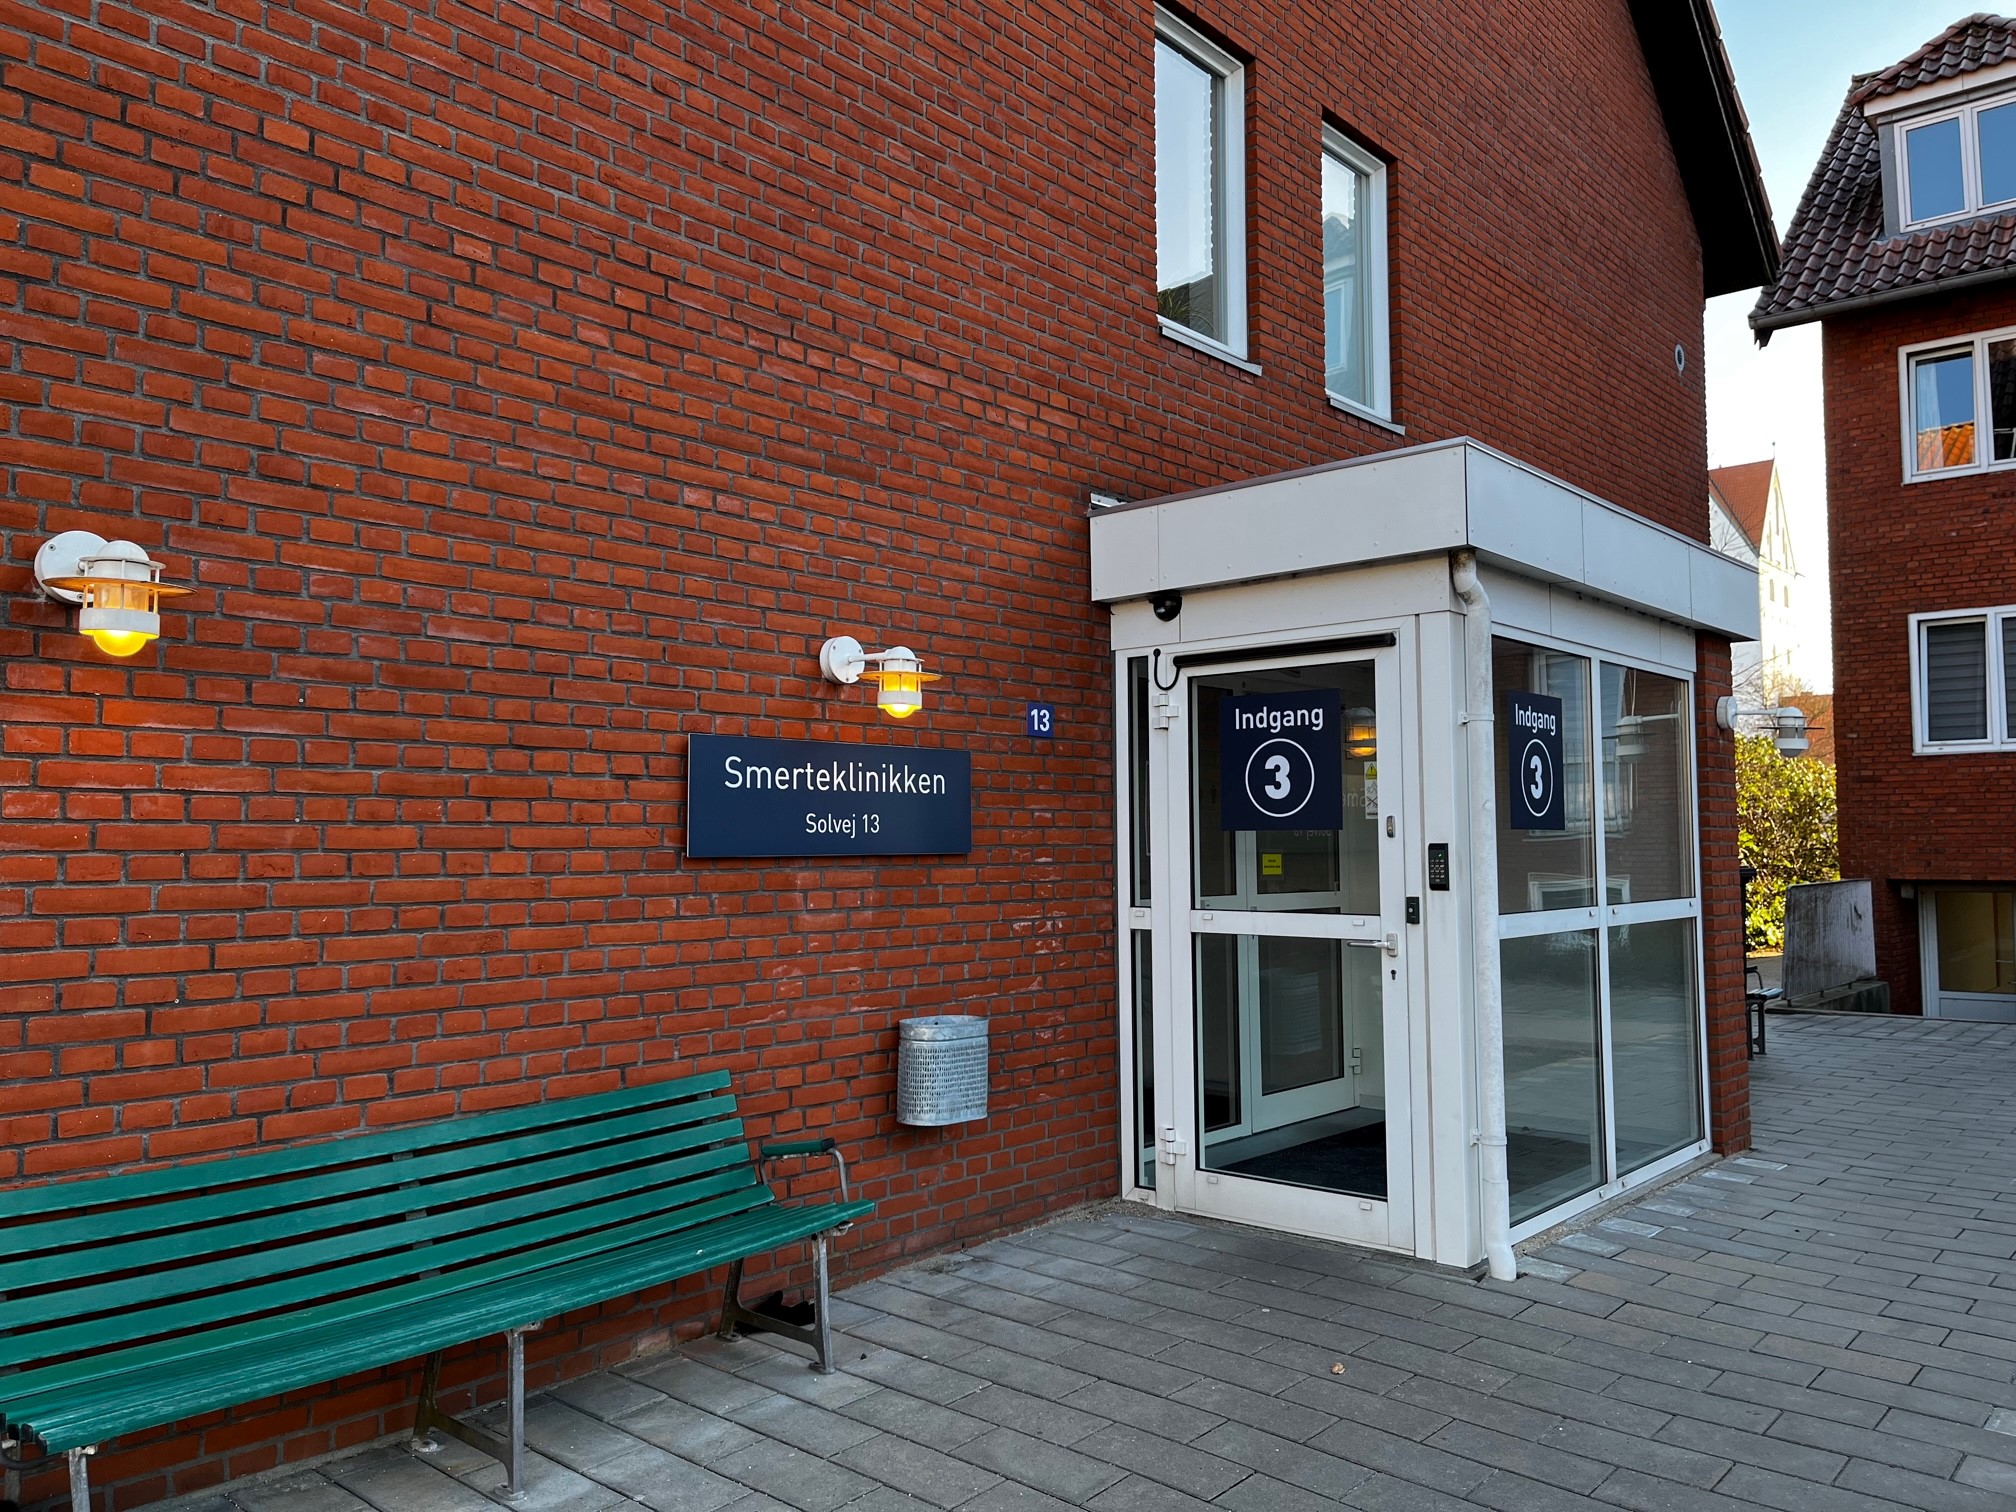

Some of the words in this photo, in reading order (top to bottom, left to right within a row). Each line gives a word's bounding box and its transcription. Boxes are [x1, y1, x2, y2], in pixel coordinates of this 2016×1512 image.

[1030, 708, 1050, 732] 13
[1235, 706, 1324, 734] Indgang
[1515, 703, 1556, 736] Indgang
[724, 755, 946, 795] Smerteklinikken
[1264, 754, 1291, 800] 3
[1530, 754, 1543, 800] 3
[805, 812, 856, 839] Solvej
[862, 813, 880, 834] 13
